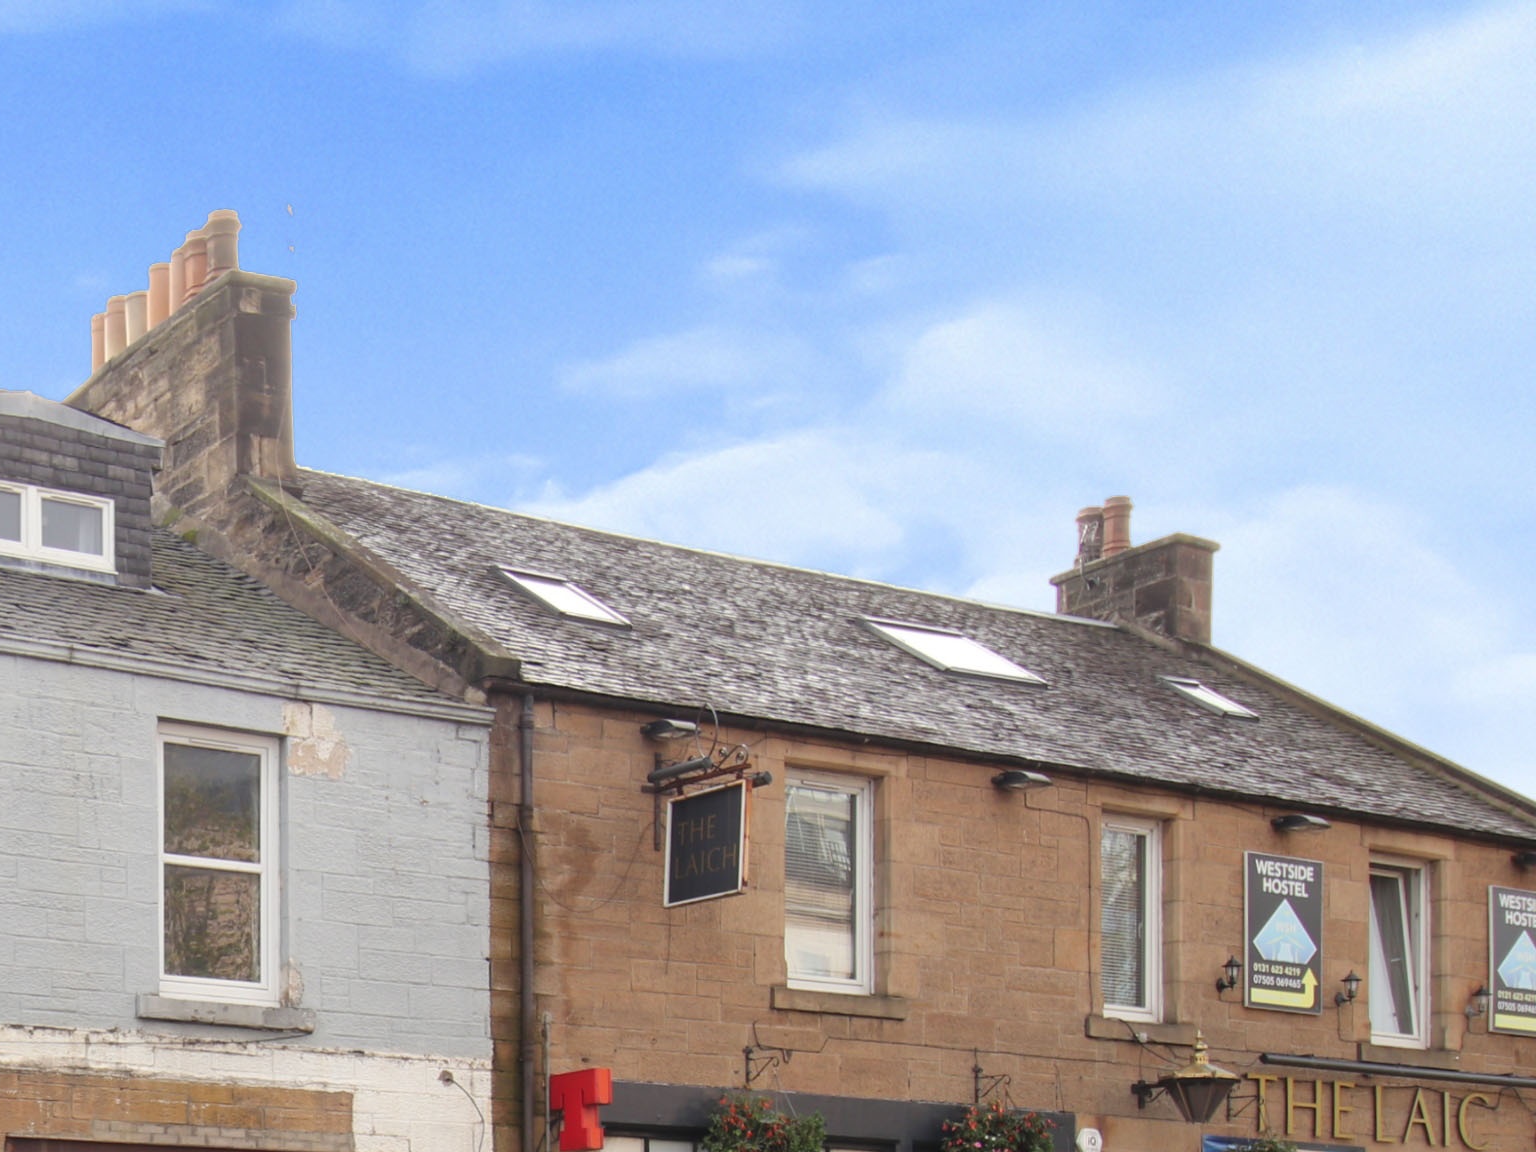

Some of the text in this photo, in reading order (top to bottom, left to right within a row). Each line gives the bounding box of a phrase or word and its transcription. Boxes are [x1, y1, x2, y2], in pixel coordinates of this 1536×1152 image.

[678, 814, 717, 846] THE
[674, 843, 737, 879] LAICH
[1255, 858, 1314, 882] WESTSIDE
[1262, 876, 1309, 898] HOSTEL
[1253, 962, 1270, 973] 0131
[1271, 965, 1284, 975] 623
[1253, 974, 1275, 986] 07505
[1247, 1072, 1357, 1141] THE
